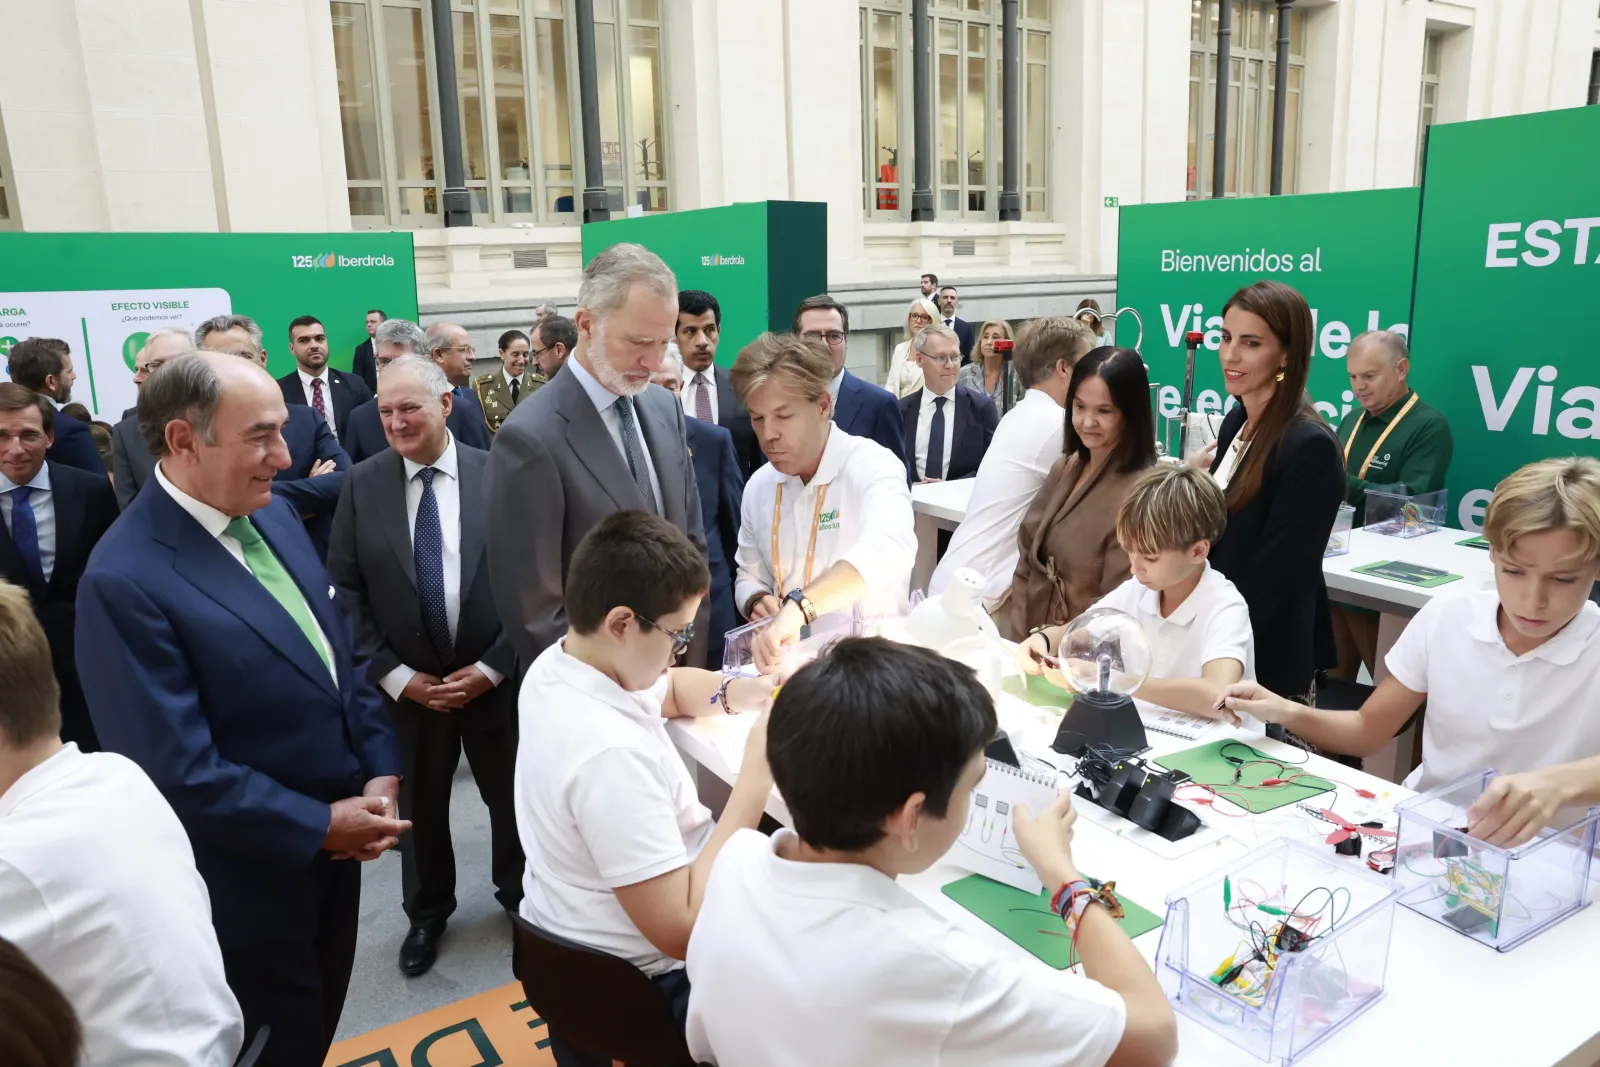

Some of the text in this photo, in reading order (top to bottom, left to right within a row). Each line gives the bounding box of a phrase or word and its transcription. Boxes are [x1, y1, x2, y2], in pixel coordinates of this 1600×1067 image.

[1485, 216, 1600, 268] EST
[291, 254, 395, 268] 125 Iberdrola
[701, 255, 745, 266] 125 Iberdrola
[1160, 246, 1322, 273] Bienvenidos al
[111, 300, 190, 311] EFECTO VISIBLE
[140, 314, 169, 322] podemos
